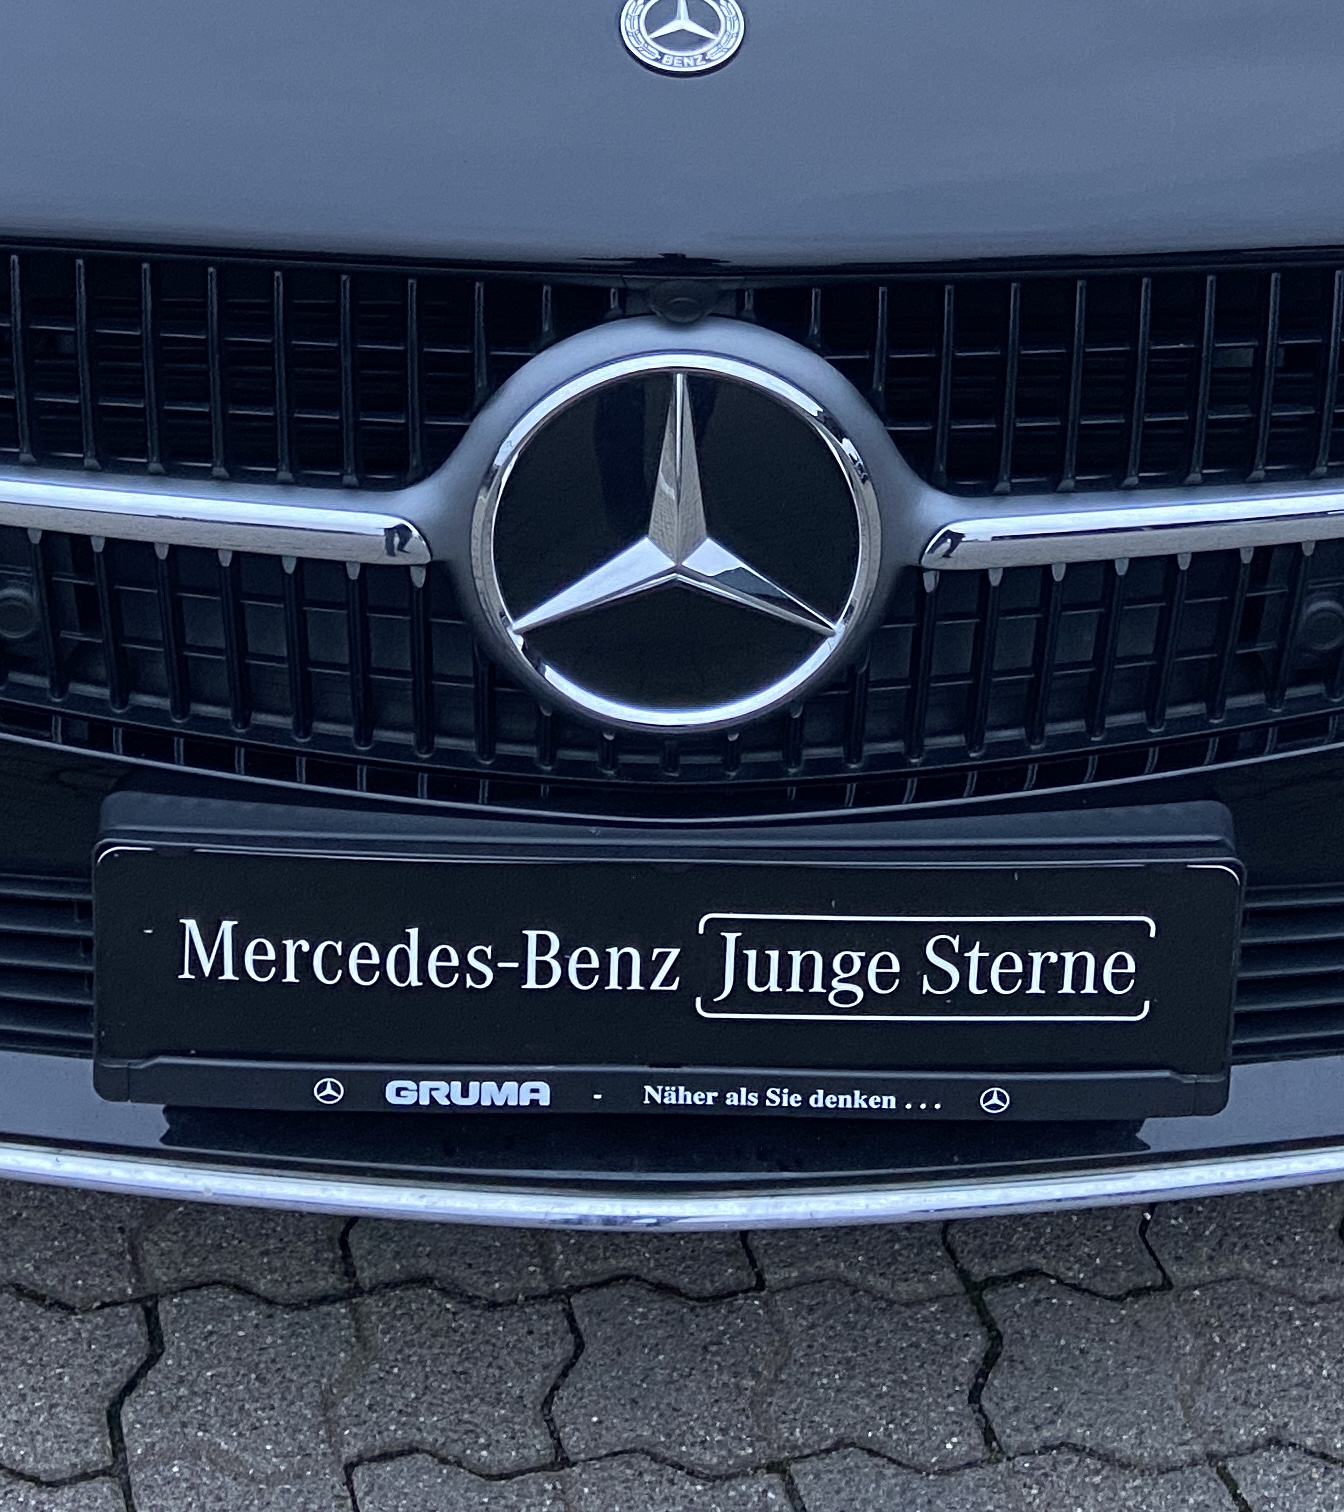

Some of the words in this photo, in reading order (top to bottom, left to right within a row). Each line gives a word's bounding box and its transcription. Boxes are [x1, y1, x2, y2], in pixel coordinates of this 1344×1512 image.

[661, 54, 707, 68] BENZ
[176, 918, 682, 992] Mercedes-Benz
[712, 930, 900, 1009] Junge
[922, 934, 1137, 996] Sterne
[385, 1079, 552, 1106] GRUMA
[643, 1084, 720, 1106] Näher
[725, 1086, 760, 1107] als
[765, 1087, 804, 1108] Sie
[808, 1089, 897, 1110] denken
